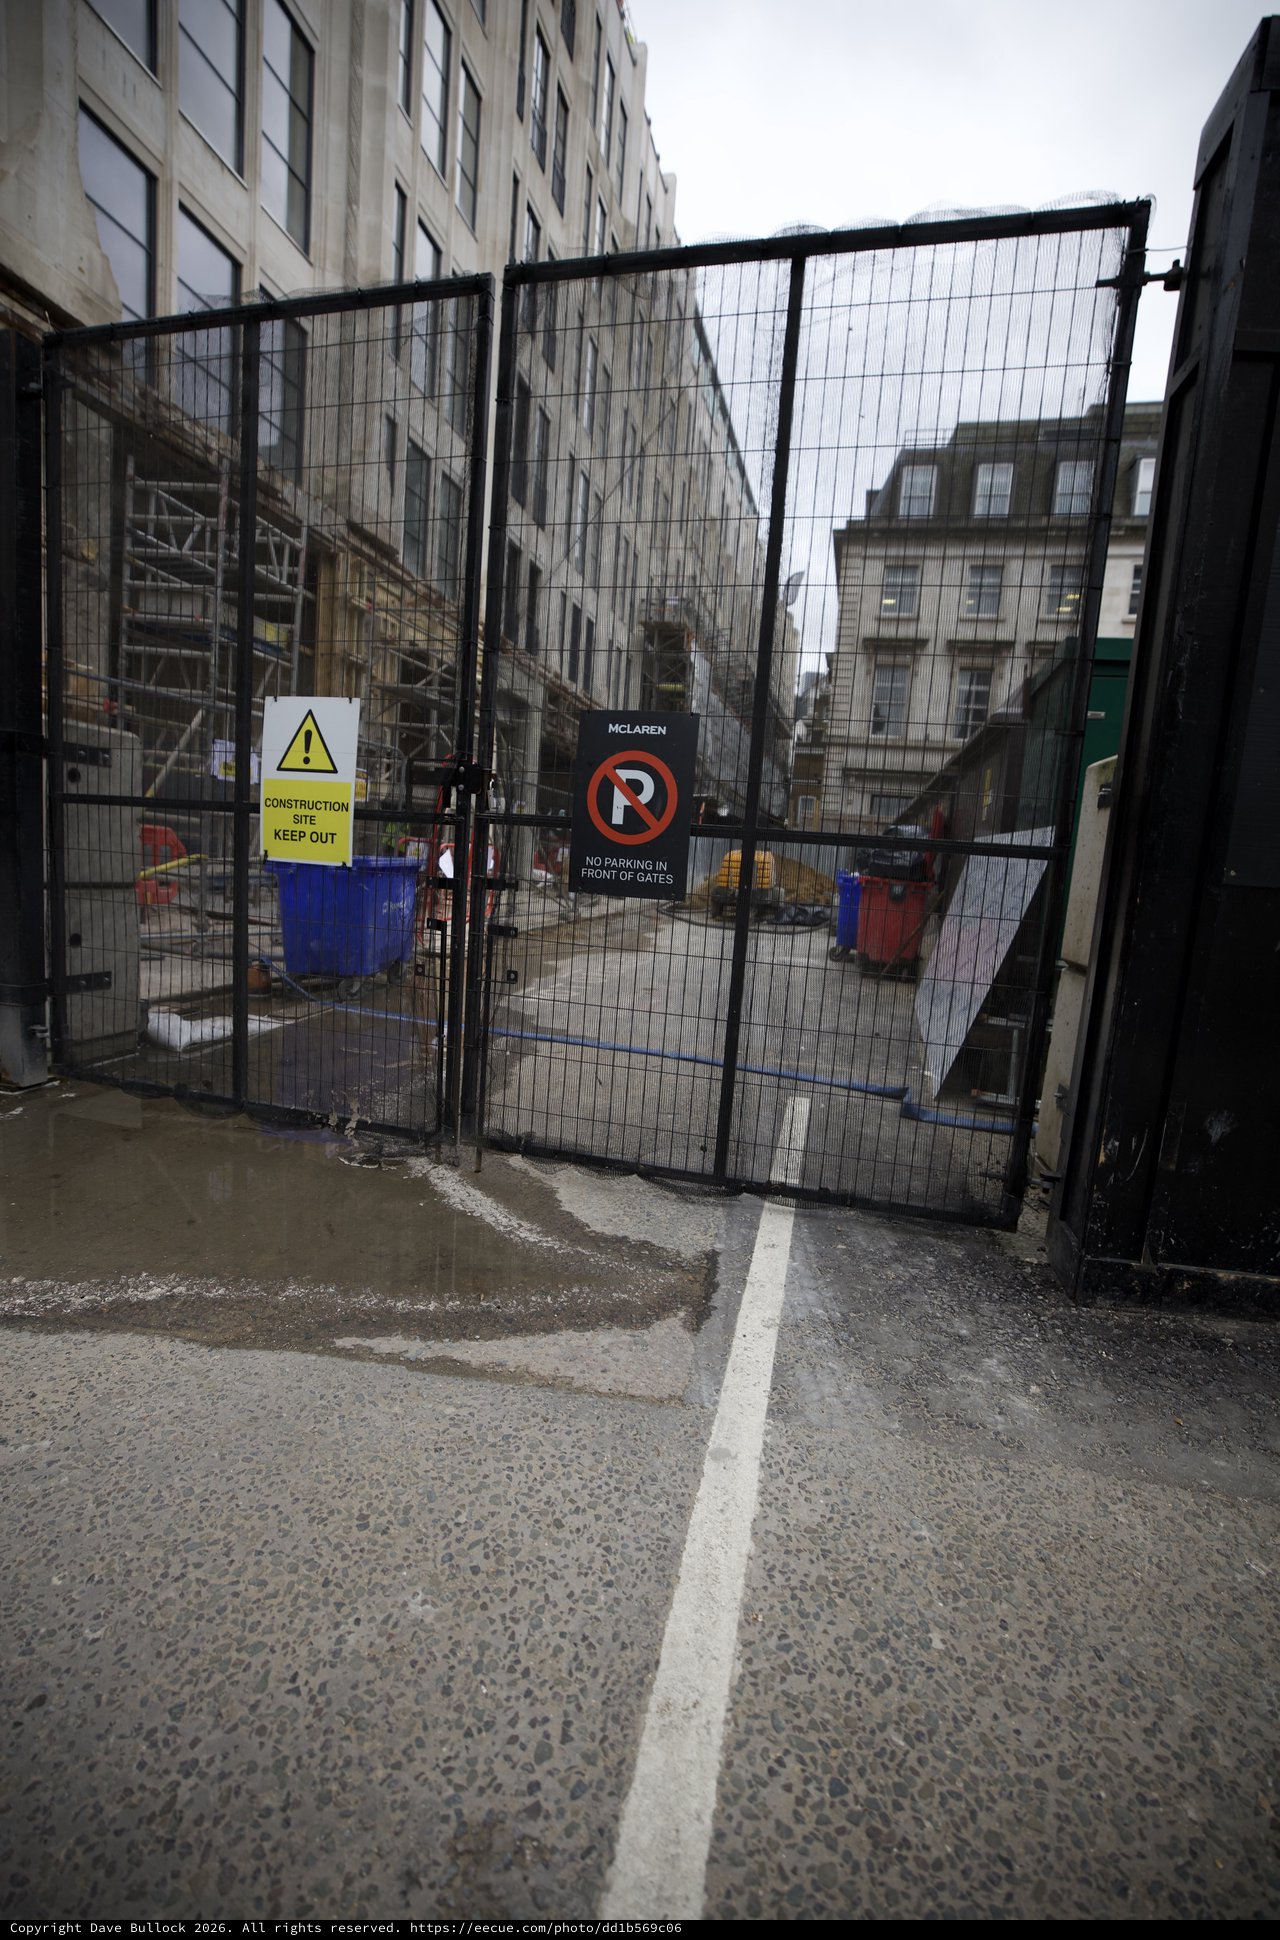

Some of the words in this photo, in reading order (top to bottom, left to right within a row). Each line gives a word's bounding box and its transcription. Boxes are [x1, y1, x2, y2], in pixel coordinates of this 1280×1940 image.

[264, 798, 349, 812] CONSTRUCTION
[293, 814, 316, 825] SITE
[274, 829, 306, 842] KEEP
[310, 831, 336, 844] OUT
[586, 856, 602, 867] NO
[604, 857, 653, 870] PARKING
[656, 861, 667, 871] IN
[581, 868, 617, 880] FRONT
[620, 870, 634, 881] OF
[637, 872, 673, 884] GATES
